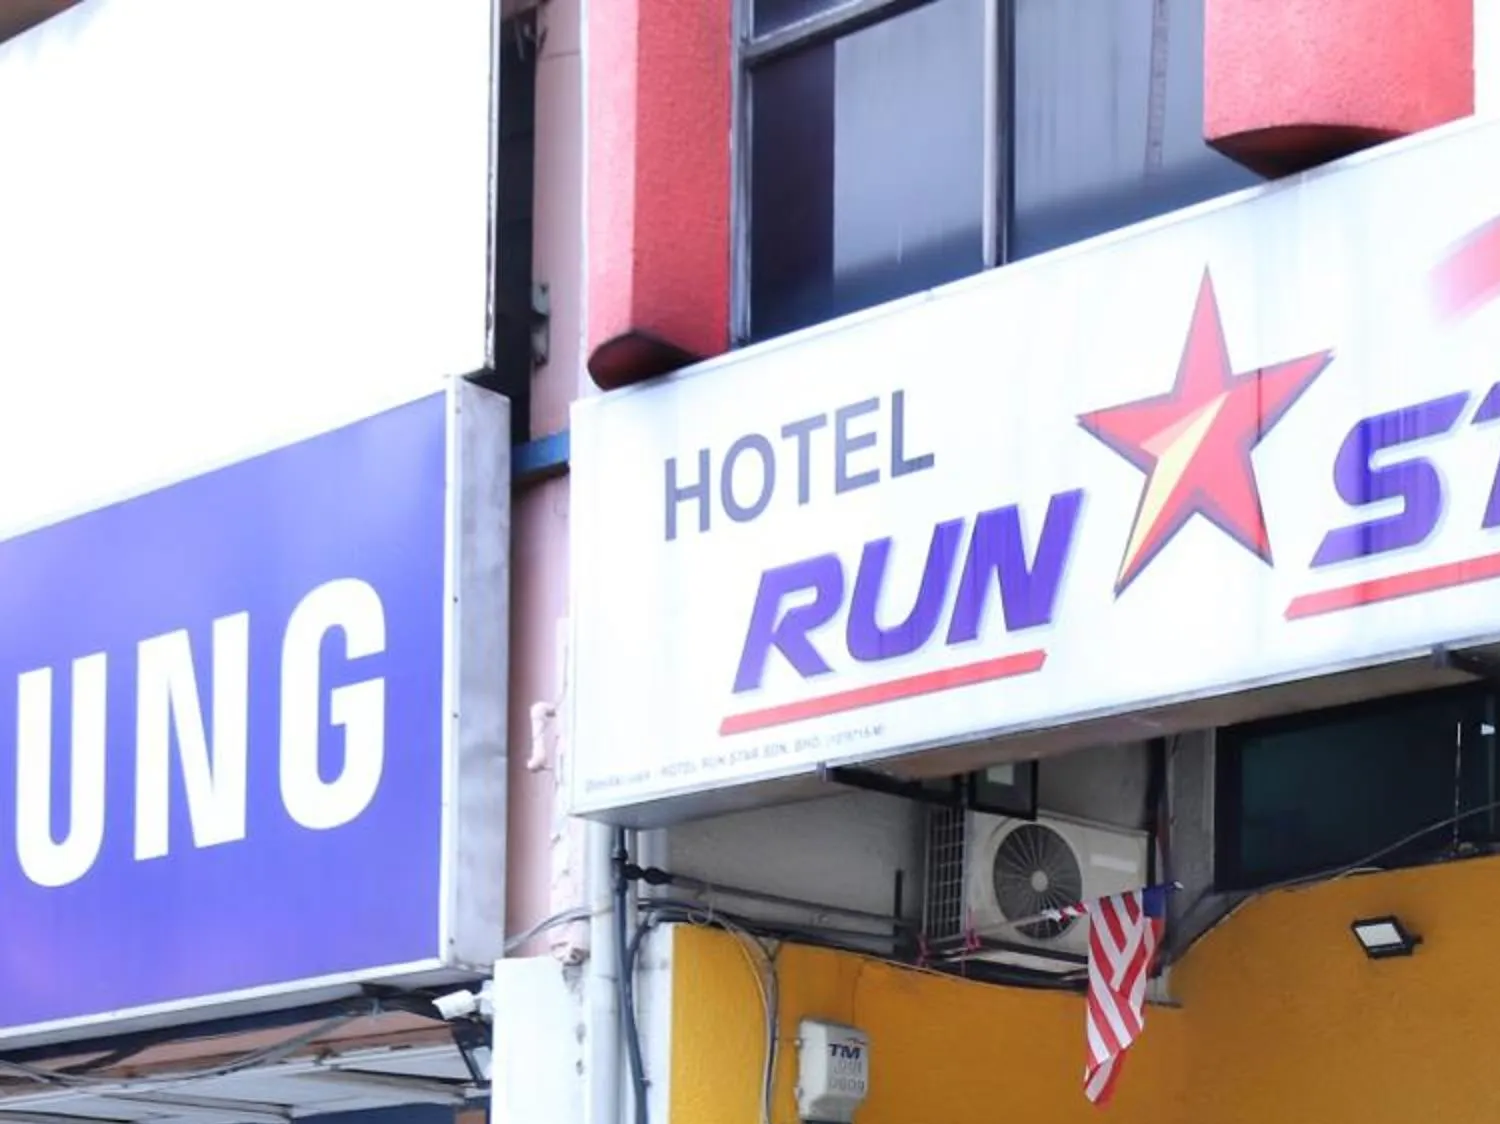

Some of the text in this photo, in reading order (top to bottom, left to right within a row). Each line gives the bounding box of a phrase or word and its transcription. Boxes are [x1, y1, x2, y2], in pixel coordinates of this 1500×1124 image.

[664, 389, 934, 541] HOTEL
[731, 487, 1086, 694] RUN
[15, 577, 386, 887] UNG
[827, 1043, 862, 1060] TM
